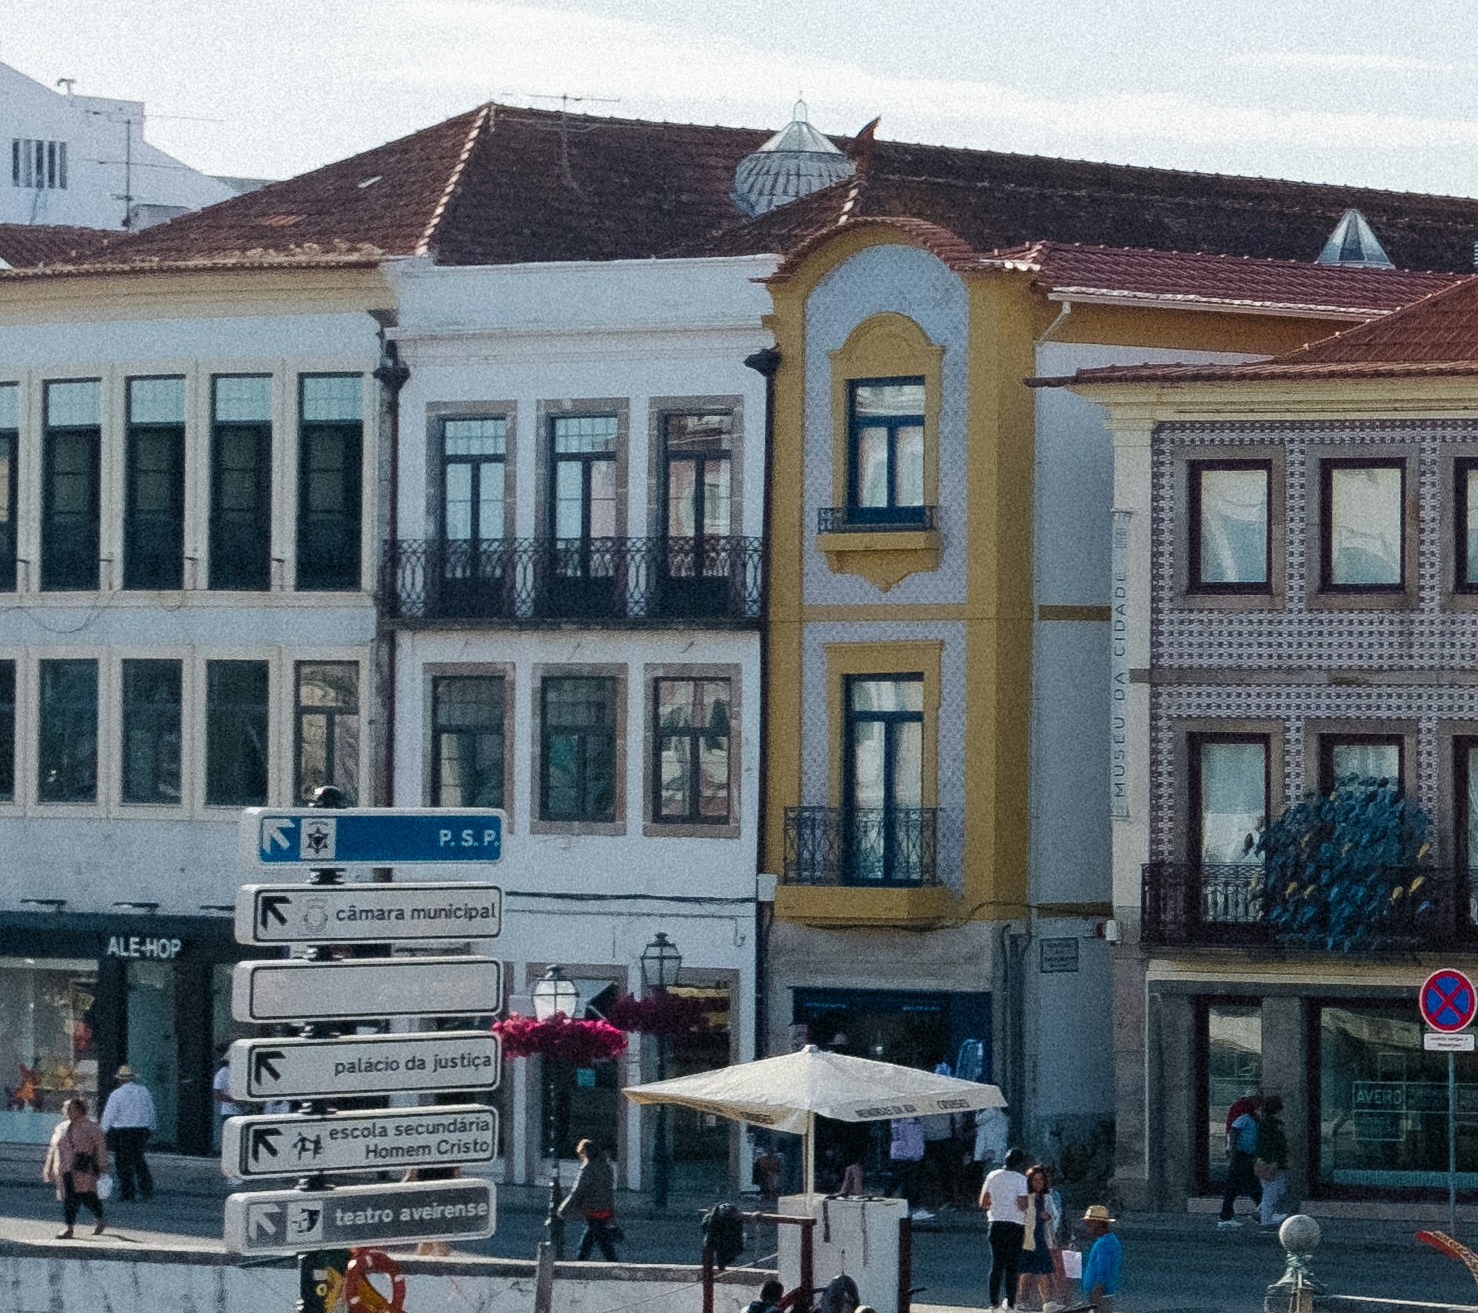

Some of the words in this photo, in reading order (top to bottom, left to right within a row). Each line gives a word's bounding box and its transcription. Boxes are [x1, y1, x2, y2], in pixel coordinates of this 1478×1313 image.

[1114, 572, 1127, 658] CIDADE
[1113, 670, 1126, 702] DA
[1113, 716, 1126, 798] MUSEU
[335, 904, 405, 921] câmara
[411, 902, 496, 922] municipal
[106, 936, 181, 958] ALE-HOP
[334, 1055, 400, 1076] palácio
[404, 1055, 426, 1071] da
[432, 1052, 492, 1073] justiça
[329, 1122, 388, 1140] escola
[393, 1116, 490, 1137] secundária
[365, 1143, 431, 1160] Homem
[436, 1139, 490, 1155] Cristo
[335, 1205, 394, 1226] teatro
[399, 1202, 488, 1222] aveirense
